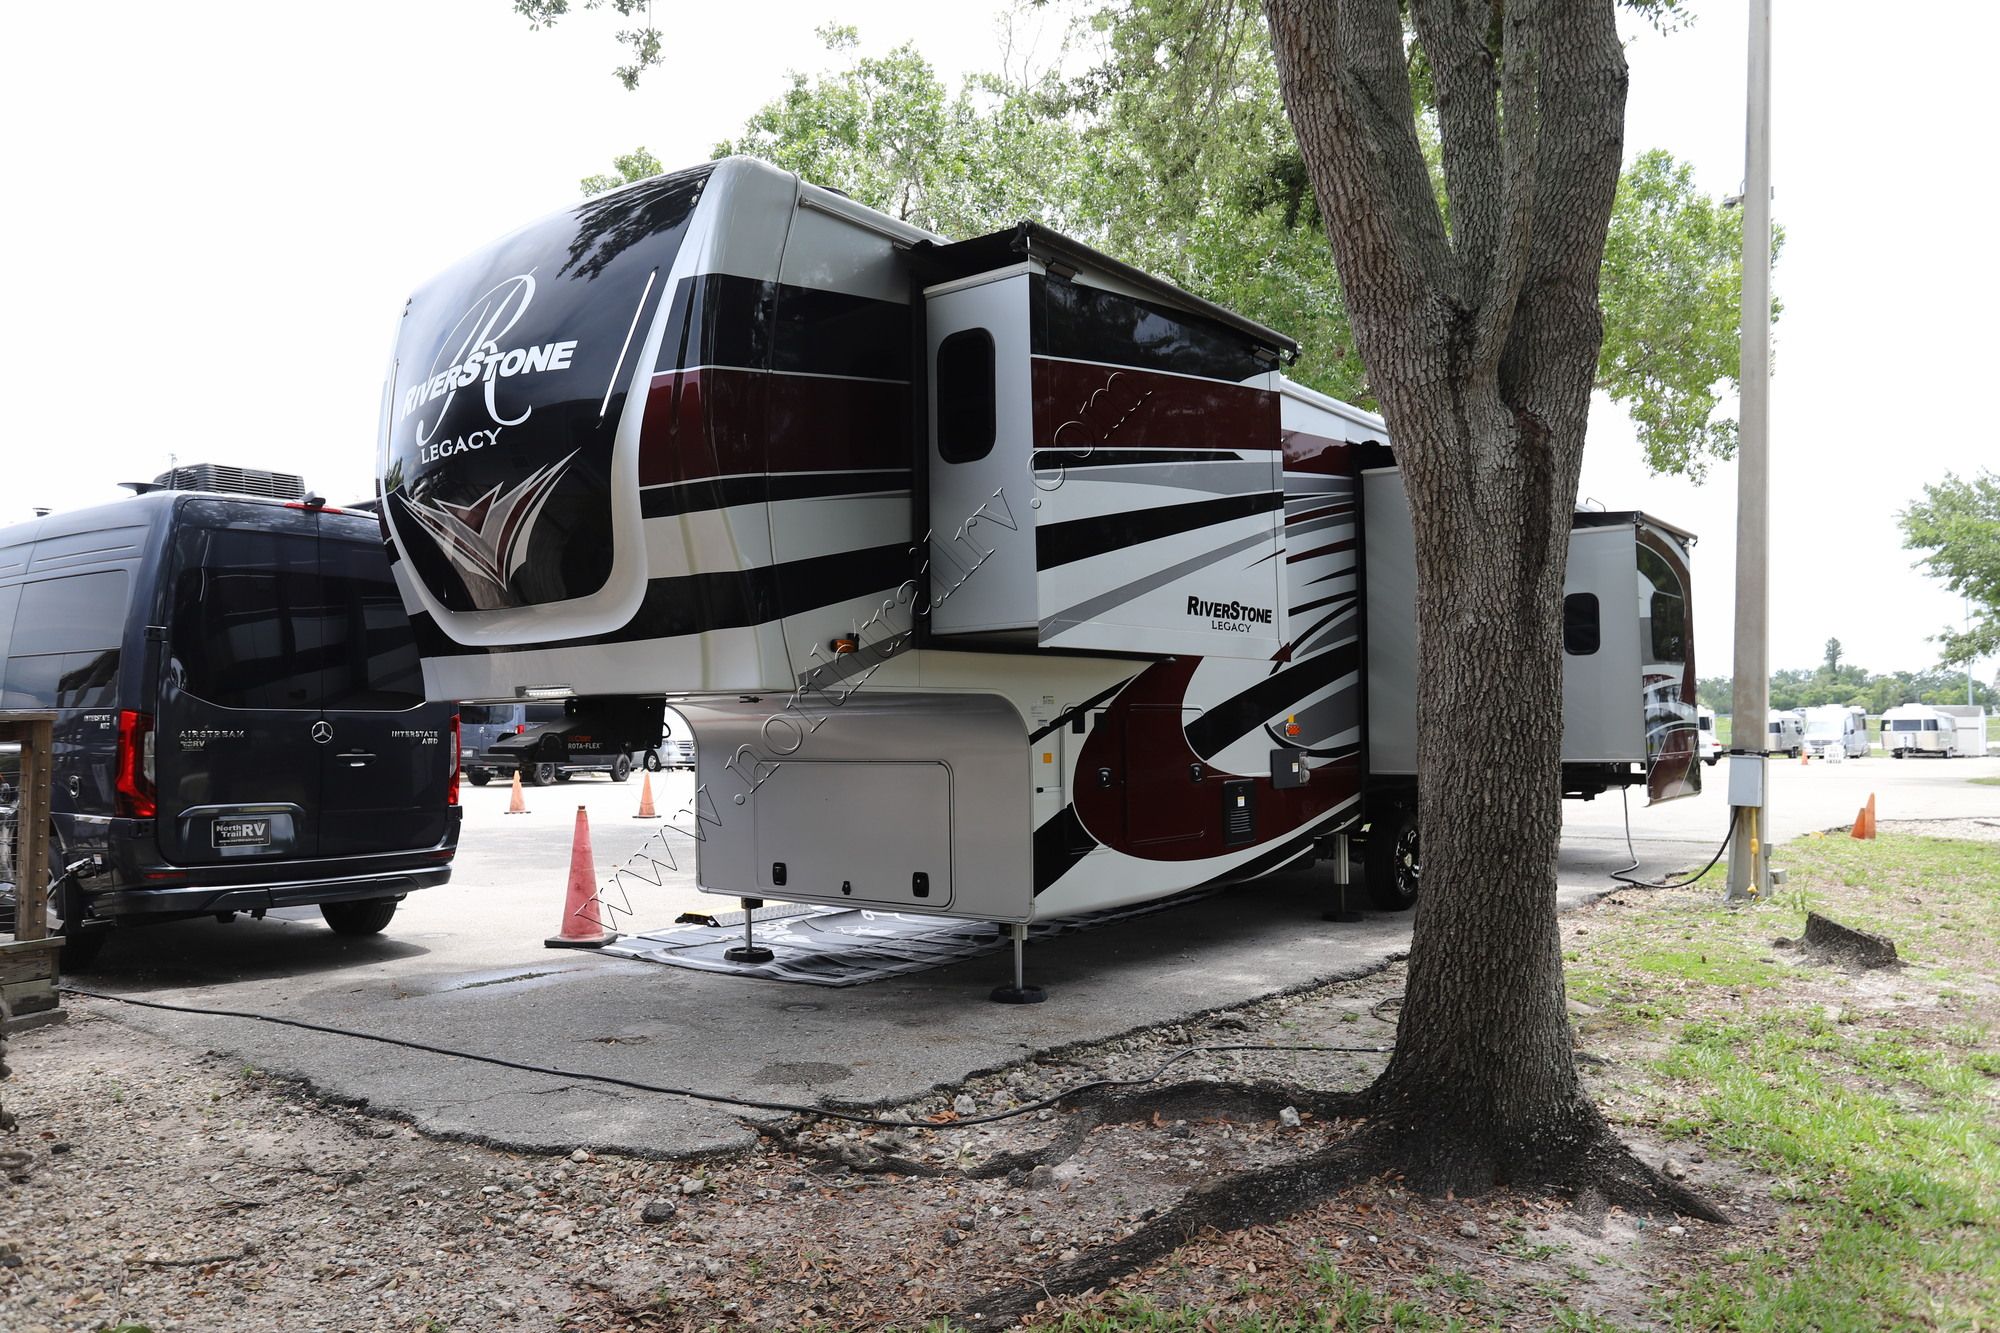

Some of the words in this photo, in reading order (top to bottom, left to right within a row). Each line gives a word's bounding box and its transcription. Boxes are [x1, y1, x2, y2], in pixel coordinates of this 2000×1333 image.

[421, 427, 502, 465] LEGACY
[1211, 620, 1251, 632] LEGACY
[179, 730, 245, 738] AIRSTREAM
[242, 823, 265, 837] RV
